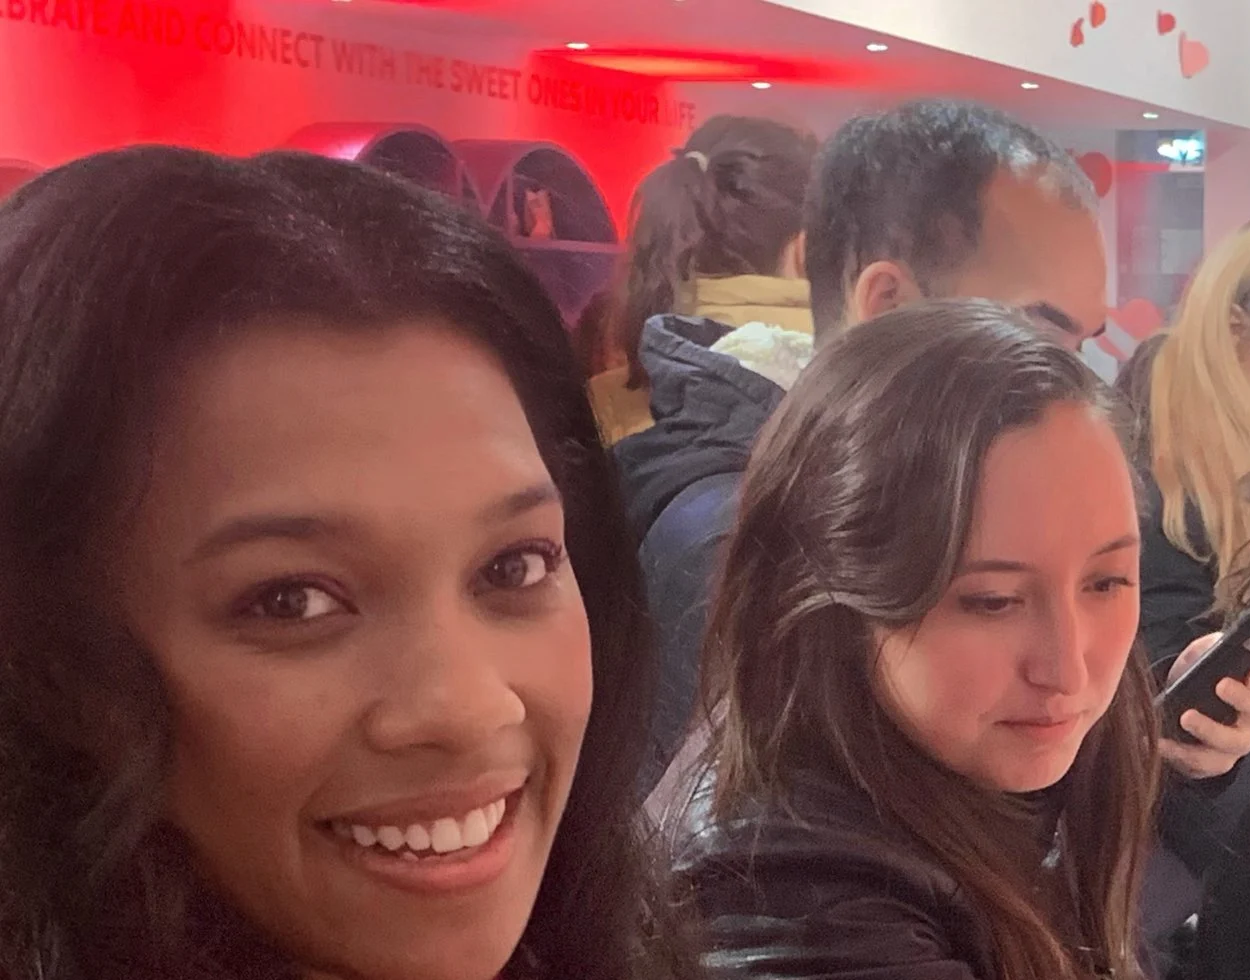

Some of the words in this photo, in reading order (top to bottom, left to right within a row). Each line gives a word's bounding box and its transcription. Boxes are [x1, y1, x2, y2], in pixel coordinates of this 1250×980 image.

[115, 0, 187, 49] AND
[195, 12, 324, 68] CONNECT
[330, 37, 396, 80] WITH
[403, 50, 446, 89] THE
[450, 60, 522, 102] SWEET
[527, 73, 581, 113] ONES
[607, 86, 659, 124] YOUR
